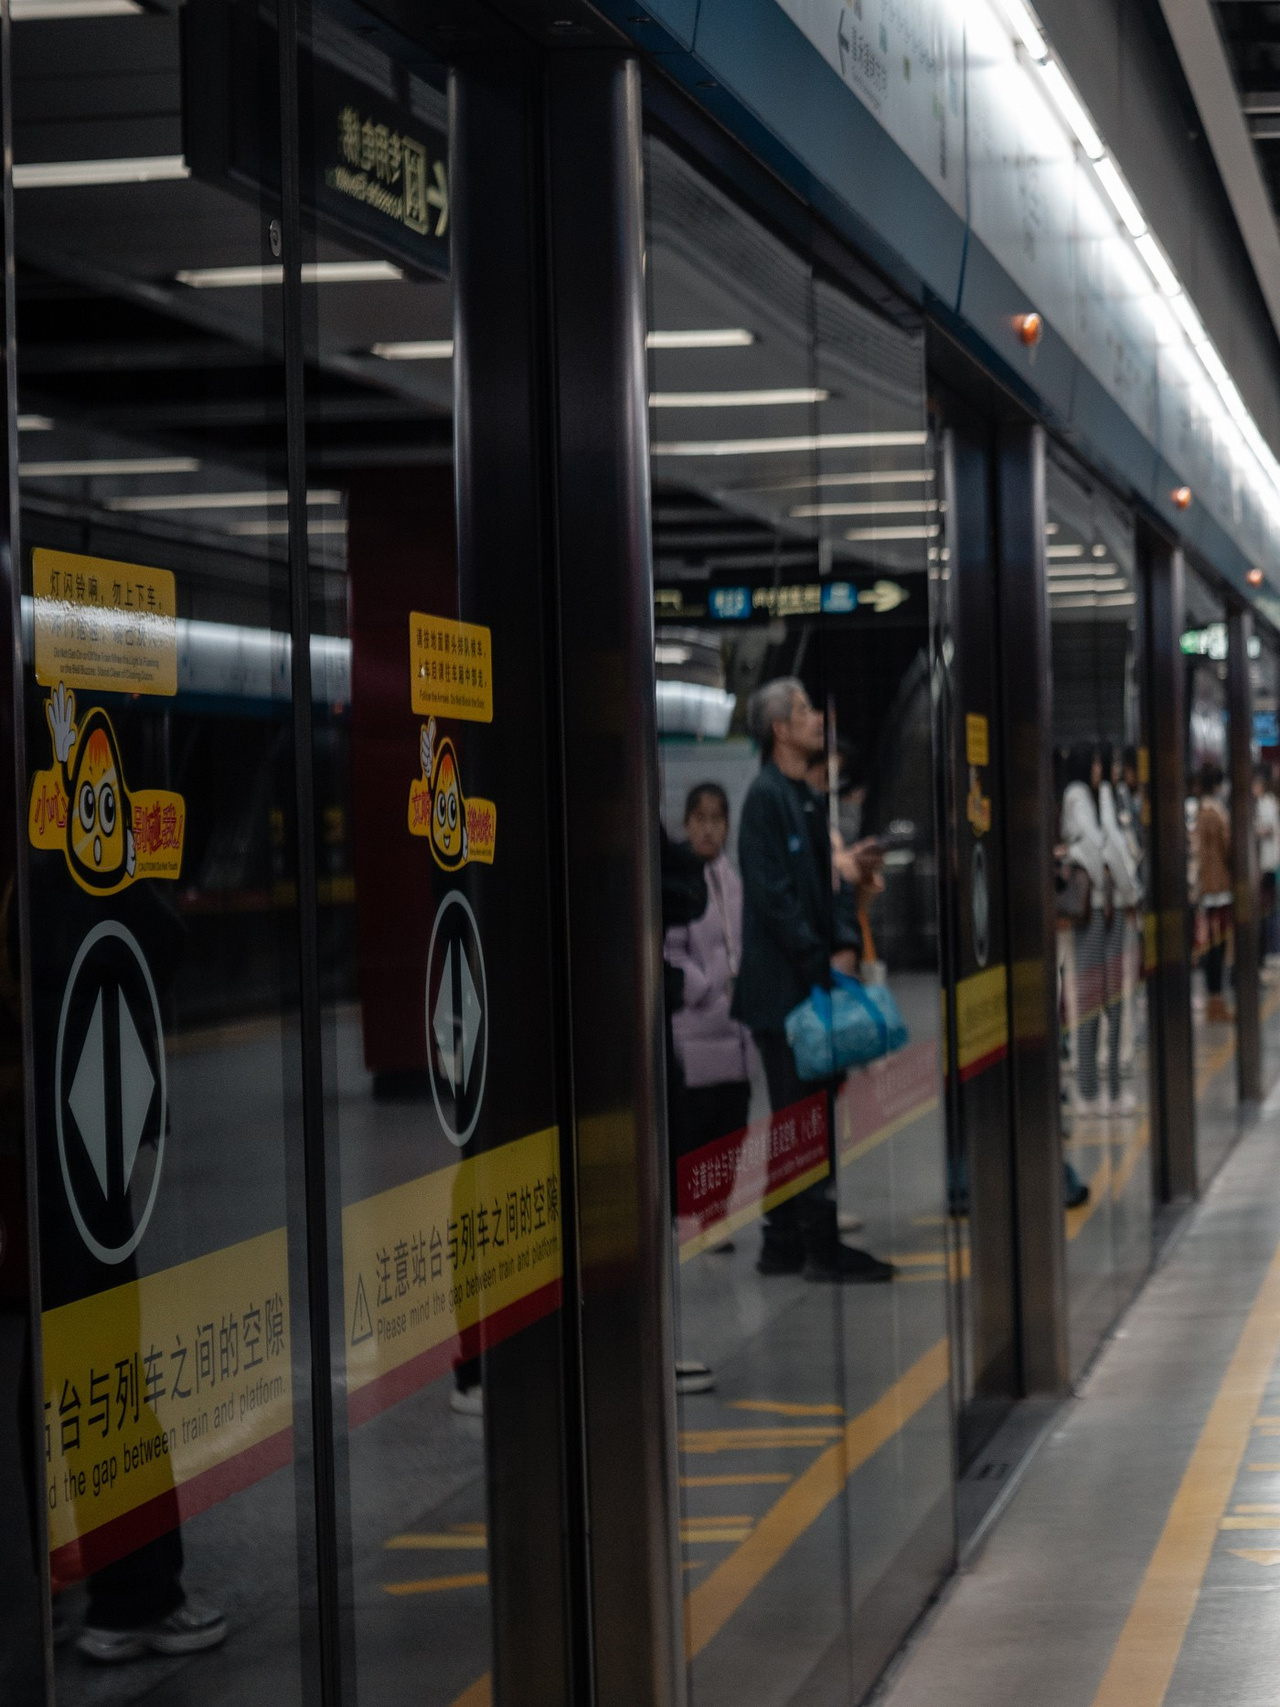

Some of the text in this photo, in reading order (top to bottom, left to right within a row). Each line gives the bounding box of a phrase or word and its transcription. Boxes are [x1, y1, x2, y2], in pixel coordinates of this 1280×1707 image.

[376, 1171, 559, 1308] 注意站台与列车之间的空隙
[377, 1315, 407, 1342] Please
[410, 1299, 430, 1328] mind
[432, 1290, 446, 1316] the
[449, 1283, 463, 1314] gap
[465, 1263, 496, 1299] between
[499, 1256, 515, 1281] train
[517, 1247, 531, 1272] and
[64, 1466, 86, 1503] the
[92, 1455, 117, 1498] gap
[123, 1427, 176, 1475] between
[182, 1409, 209, 1445] train
[214, 1392, 233, 1429] and
[239, 1374, 286, 1423] platform.
